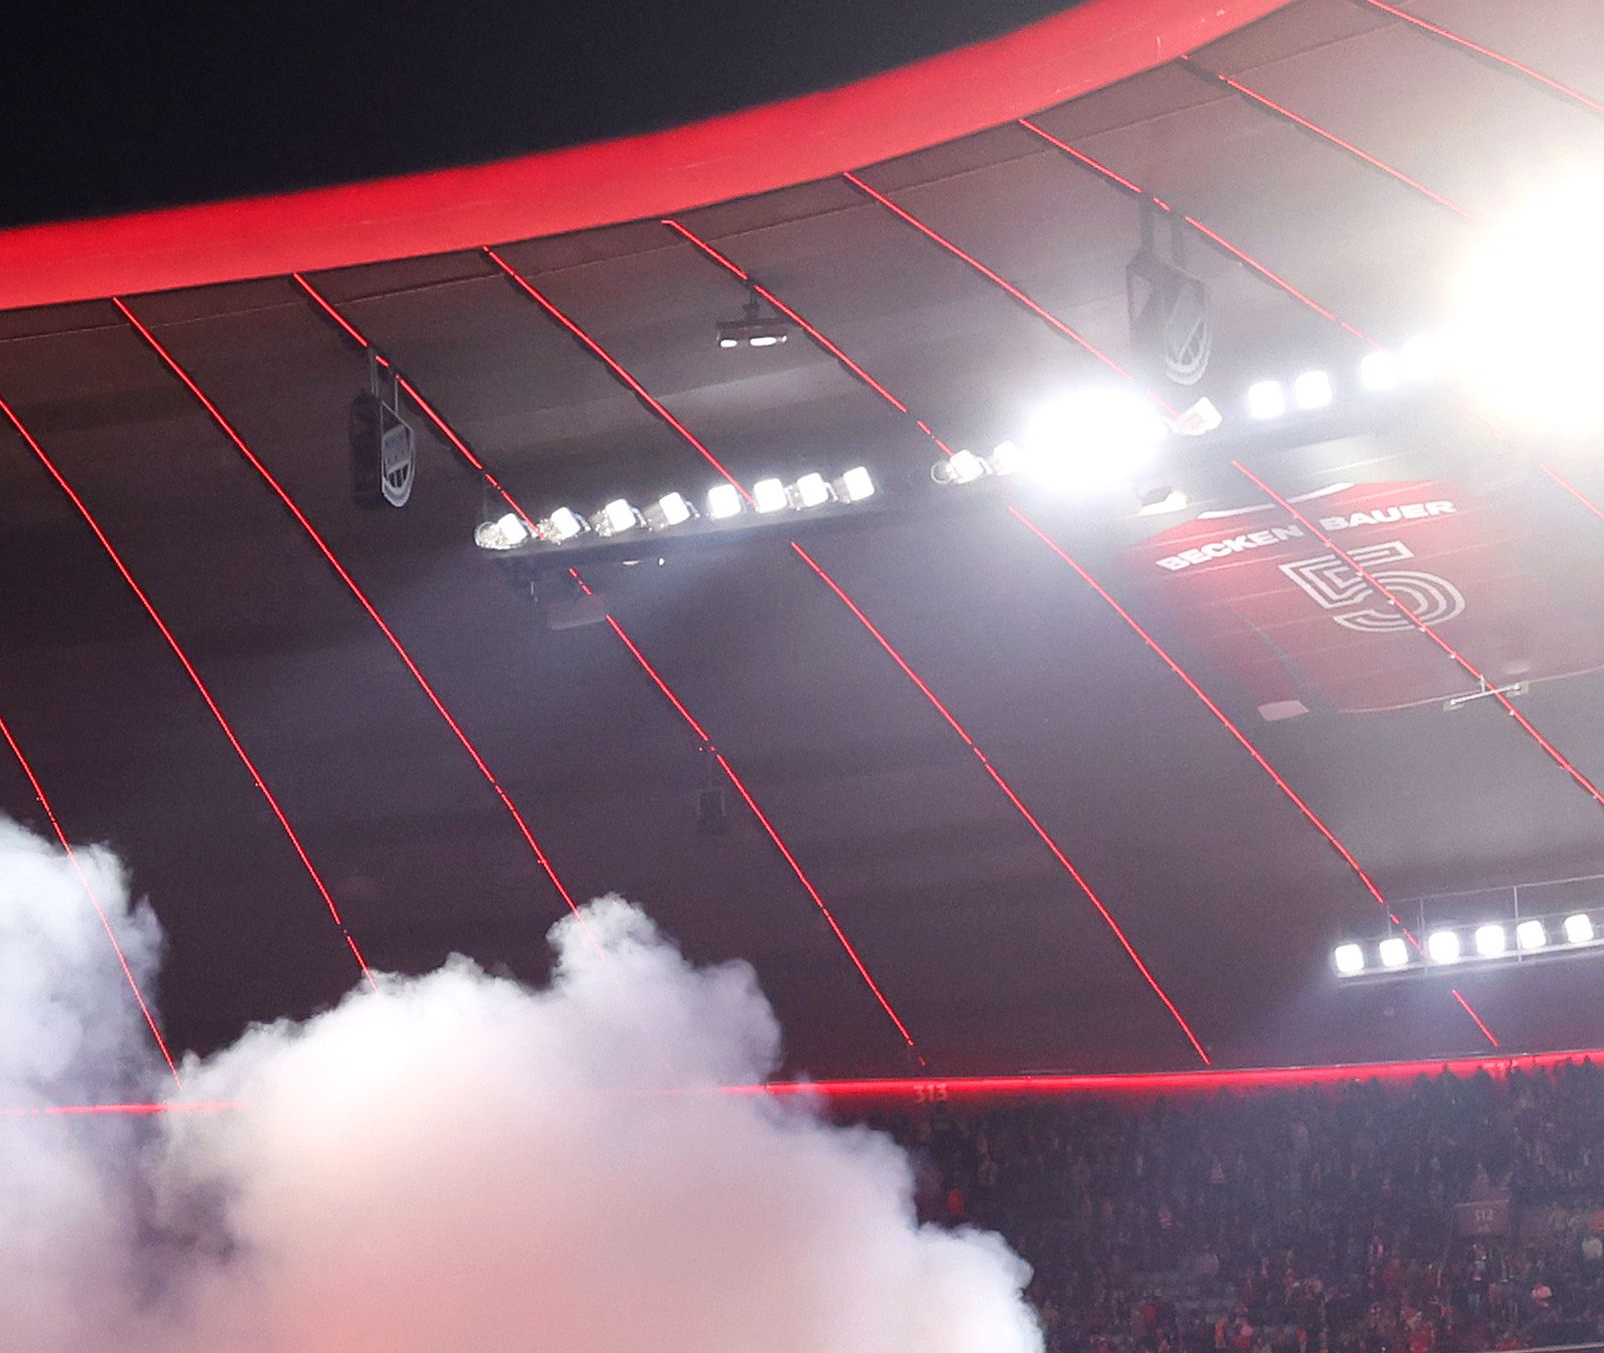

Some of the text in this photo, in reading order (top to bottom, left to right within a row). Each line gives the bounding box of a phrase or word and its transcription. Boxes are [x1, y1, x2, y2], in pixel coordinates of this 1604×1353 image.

[1156, 500, 1456, 571] BECKEN BAUER
[1278, 540, 1466, 633] 5
